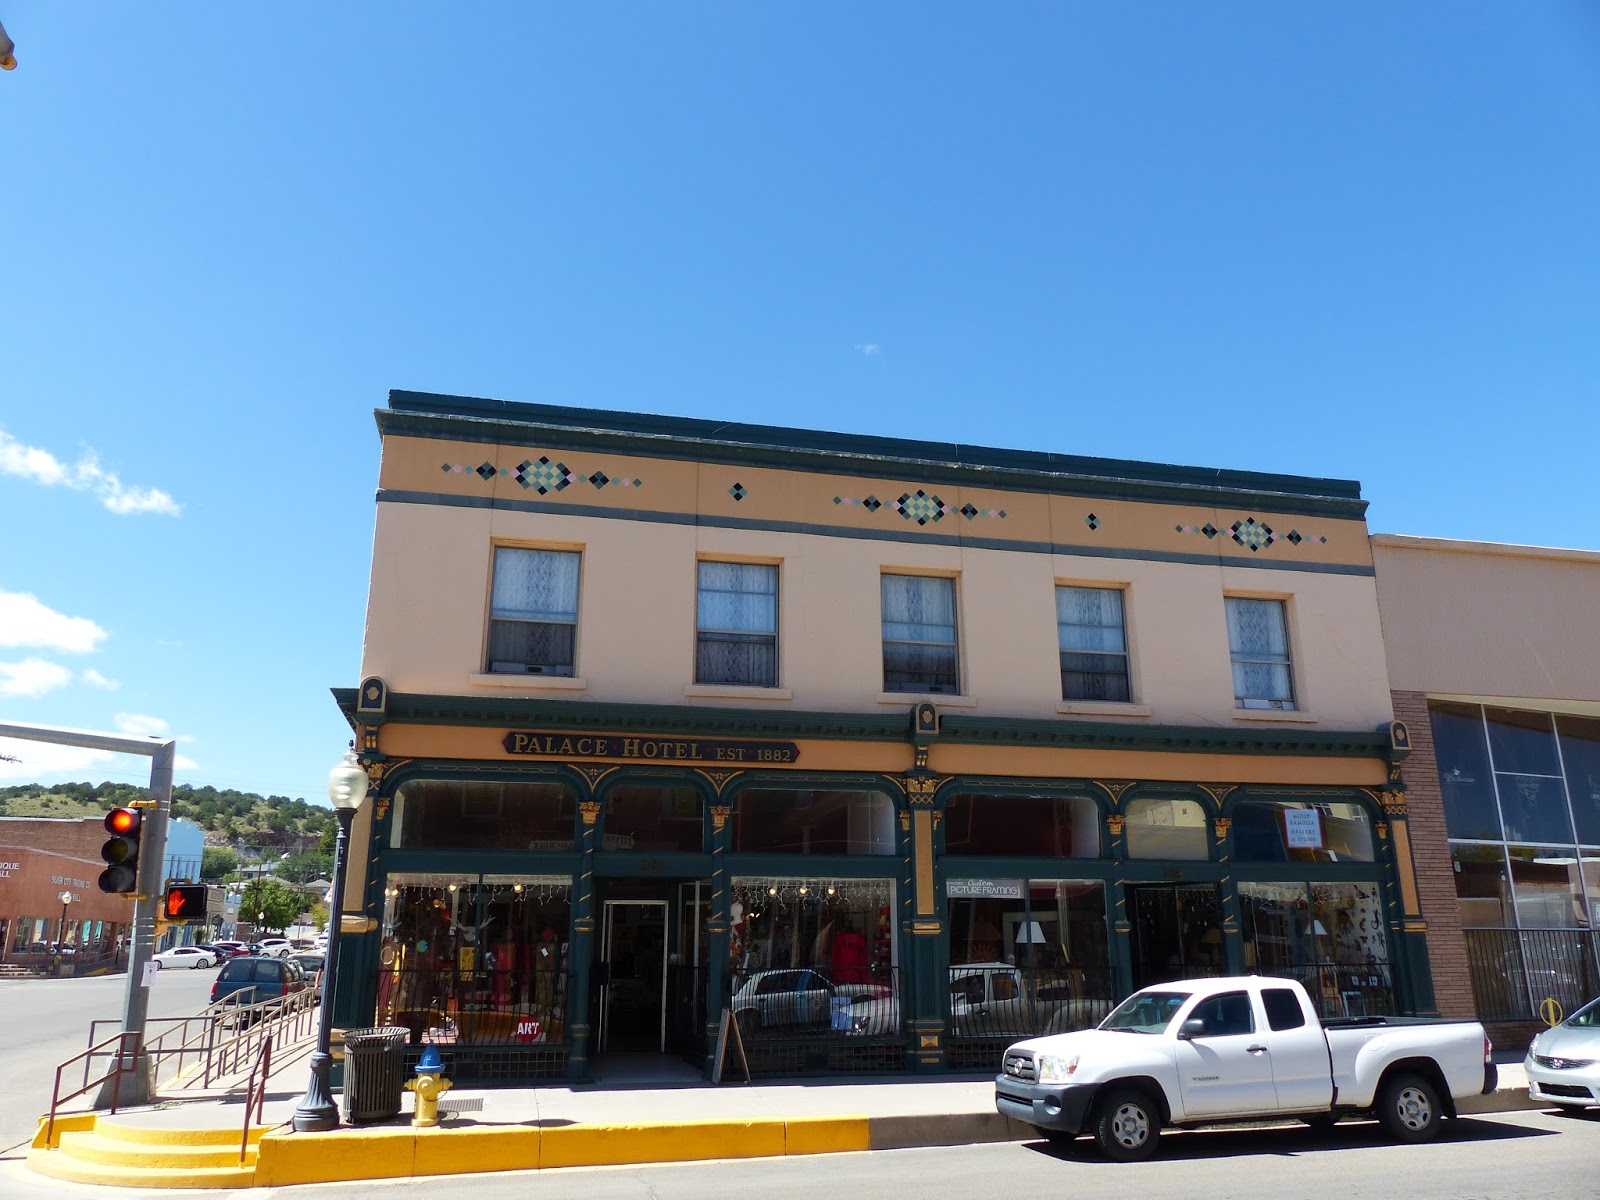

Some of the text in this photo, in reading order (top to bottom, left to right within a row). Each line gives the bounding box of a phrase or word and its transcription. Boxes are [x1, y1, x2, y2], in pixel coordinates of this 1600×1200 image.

[513, 733, 791, 762] PALACE HOTEL EST 1882
[950, 886, 1018, 895] PICTURE FRAMING
[517, 1022, 540, 1035] ART
